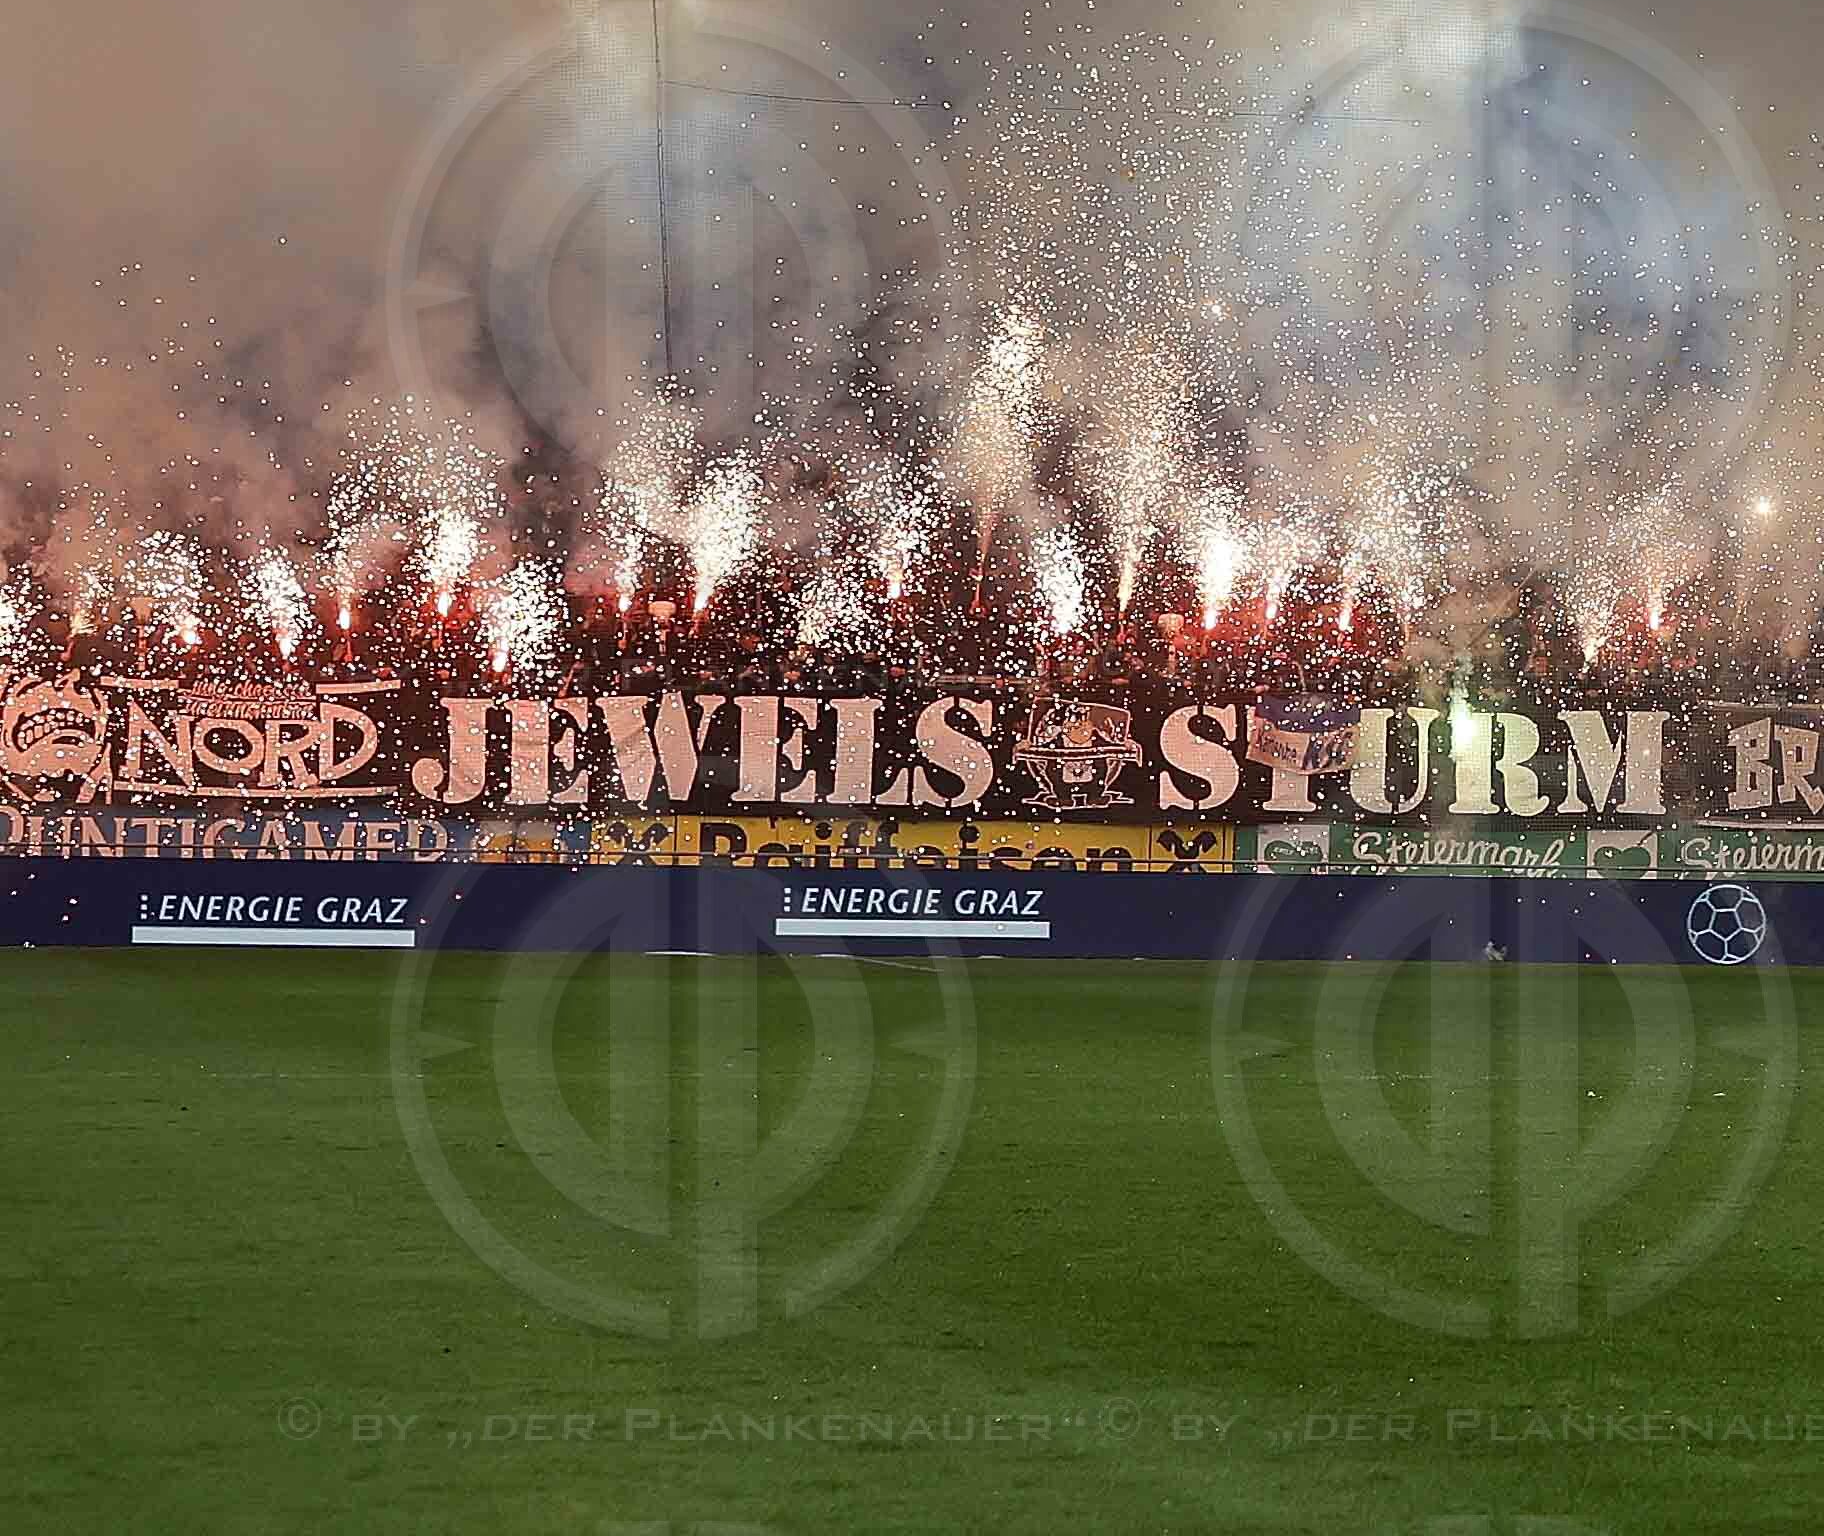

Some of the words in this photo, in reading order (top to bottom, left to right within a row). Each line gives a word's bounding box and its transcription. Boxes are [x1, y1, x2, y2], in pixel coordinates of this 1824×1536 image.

[119, 700, 378, 791] NORD
[411, 691, 995, 807] JEWELS
[158, 893, 309, 923] ENERGIE
[317, 895, 410, 925] GRAZ
[800, 886, 942, 915] ENERGIE
[954, 888, 1043, 917] GRAZ
